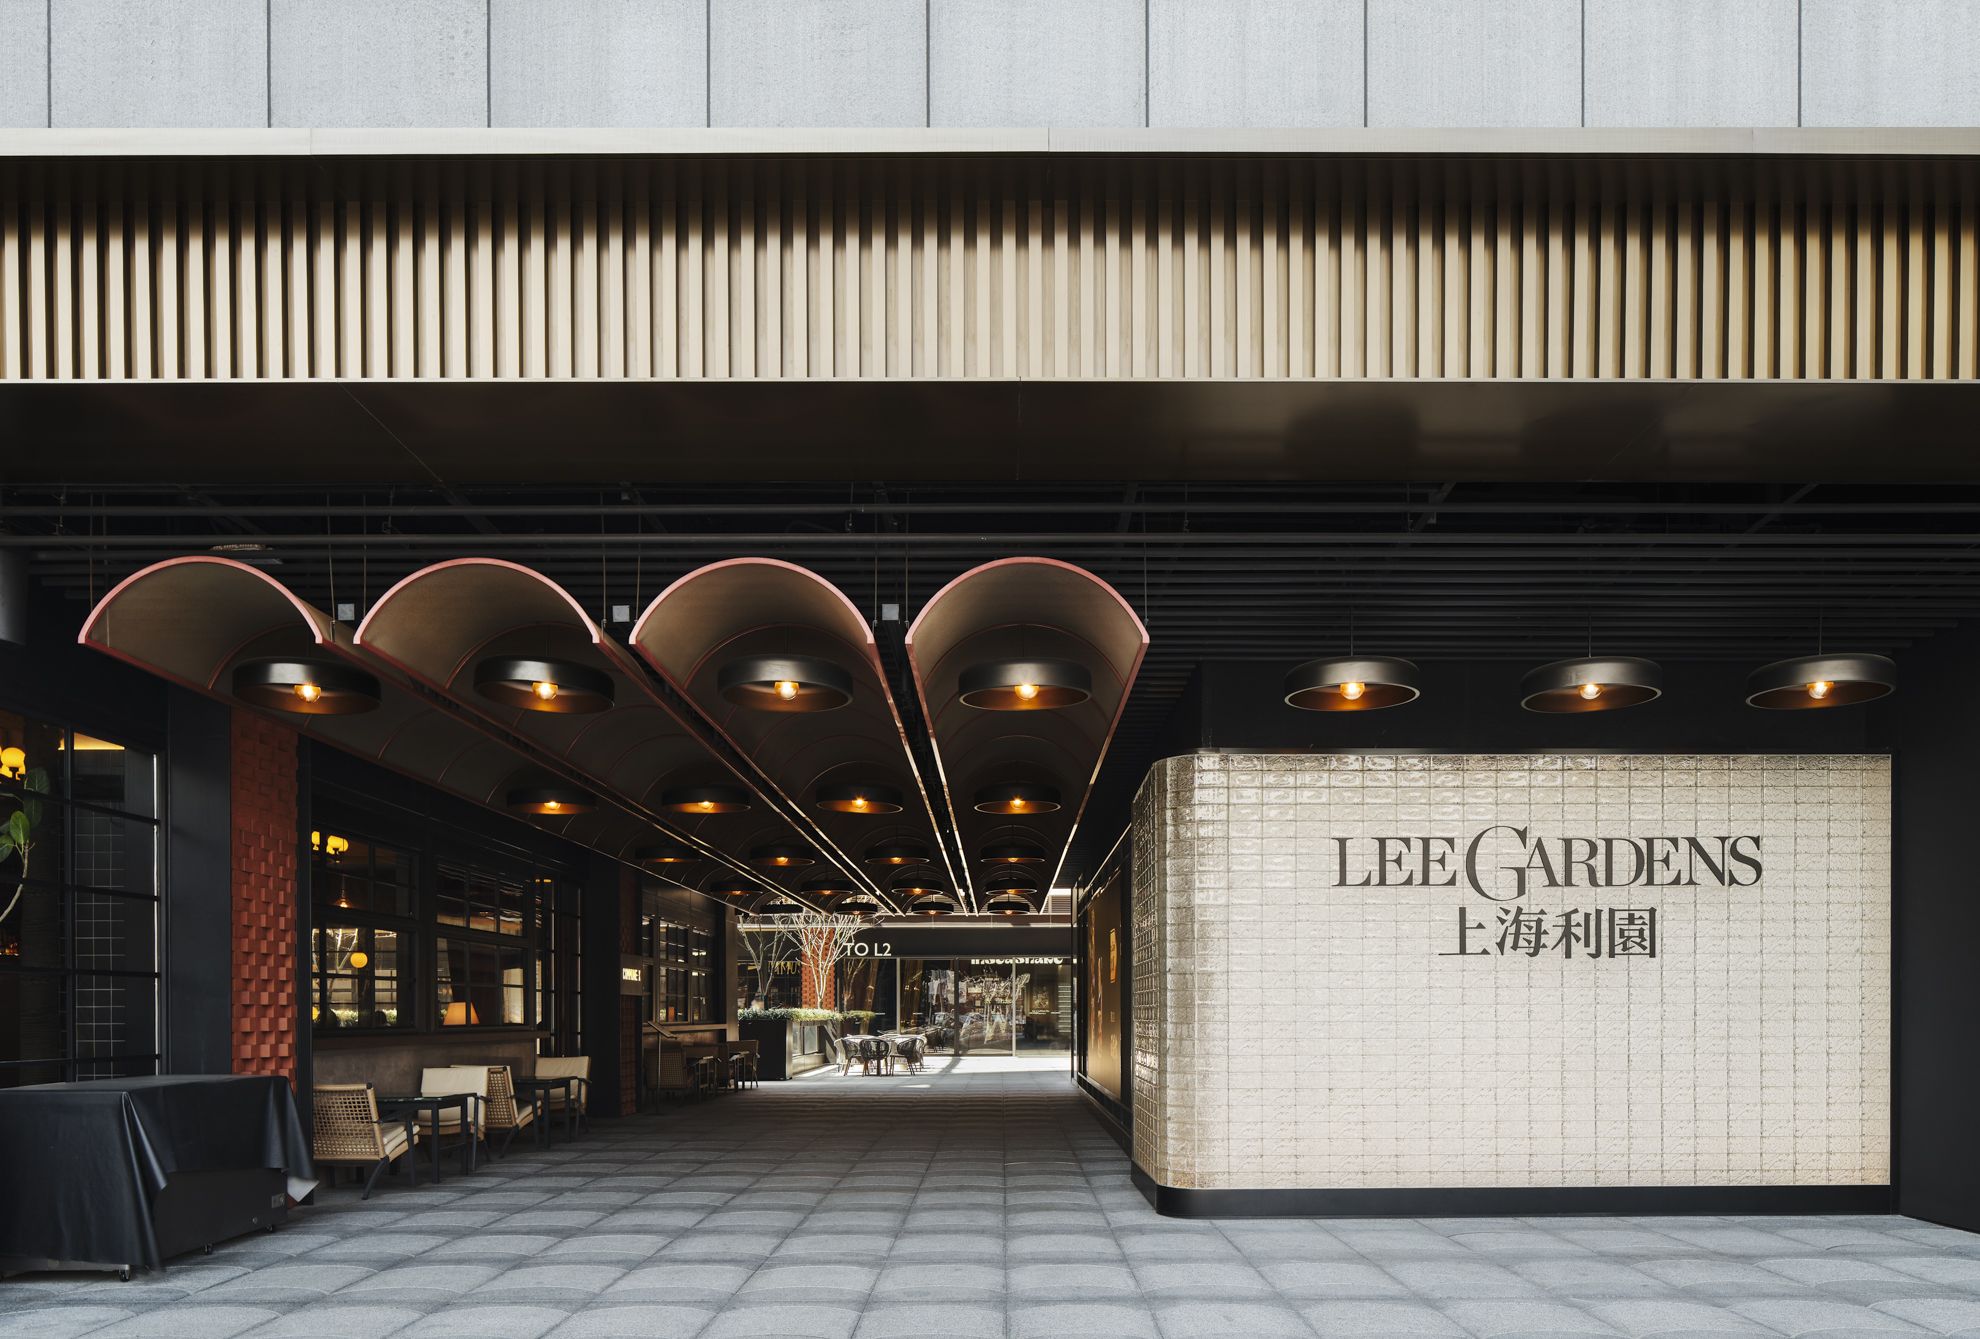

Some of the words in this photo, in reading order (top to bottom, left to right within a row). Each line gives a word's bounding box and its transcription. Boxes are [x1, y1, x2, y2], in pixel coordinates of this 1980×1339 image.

[1331, 836, 1457, 888] LEE
[1465, 825, 1763, 902] GARDENS
[844, 942, 869, 957] TO
[874, 942, 892, 957] L2
[1438, 906, 1658, 959] 上海利園
